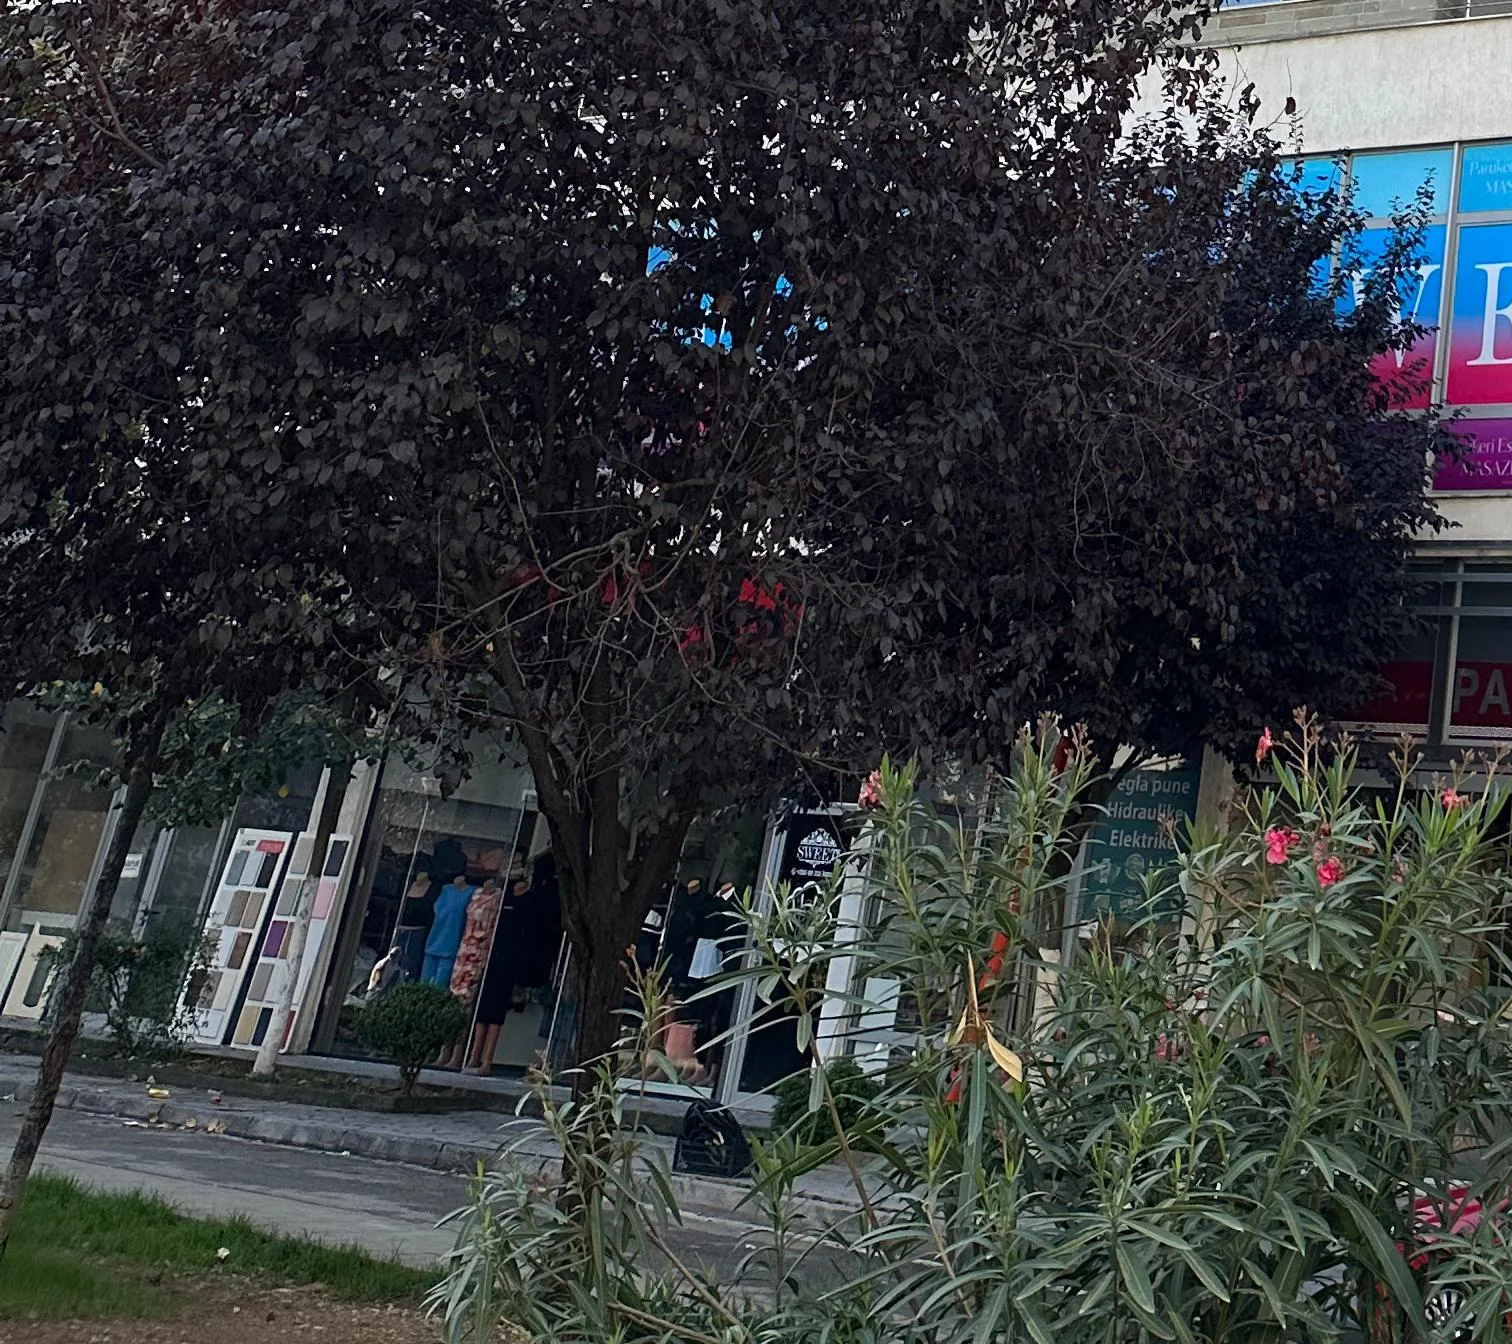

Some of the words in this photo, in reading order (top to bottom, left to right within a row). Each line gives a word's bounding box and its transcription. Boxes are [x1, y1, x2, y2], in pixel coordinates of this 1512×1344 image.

[1117, 775, 1147, 795] egla
[1151, 779, 1190, 796] pune
[1107, 801, 1184, 821] Hidraulike
[1109, 828, 1175, 849] Elektrike
[796, 845, 840, 861] SWEET
